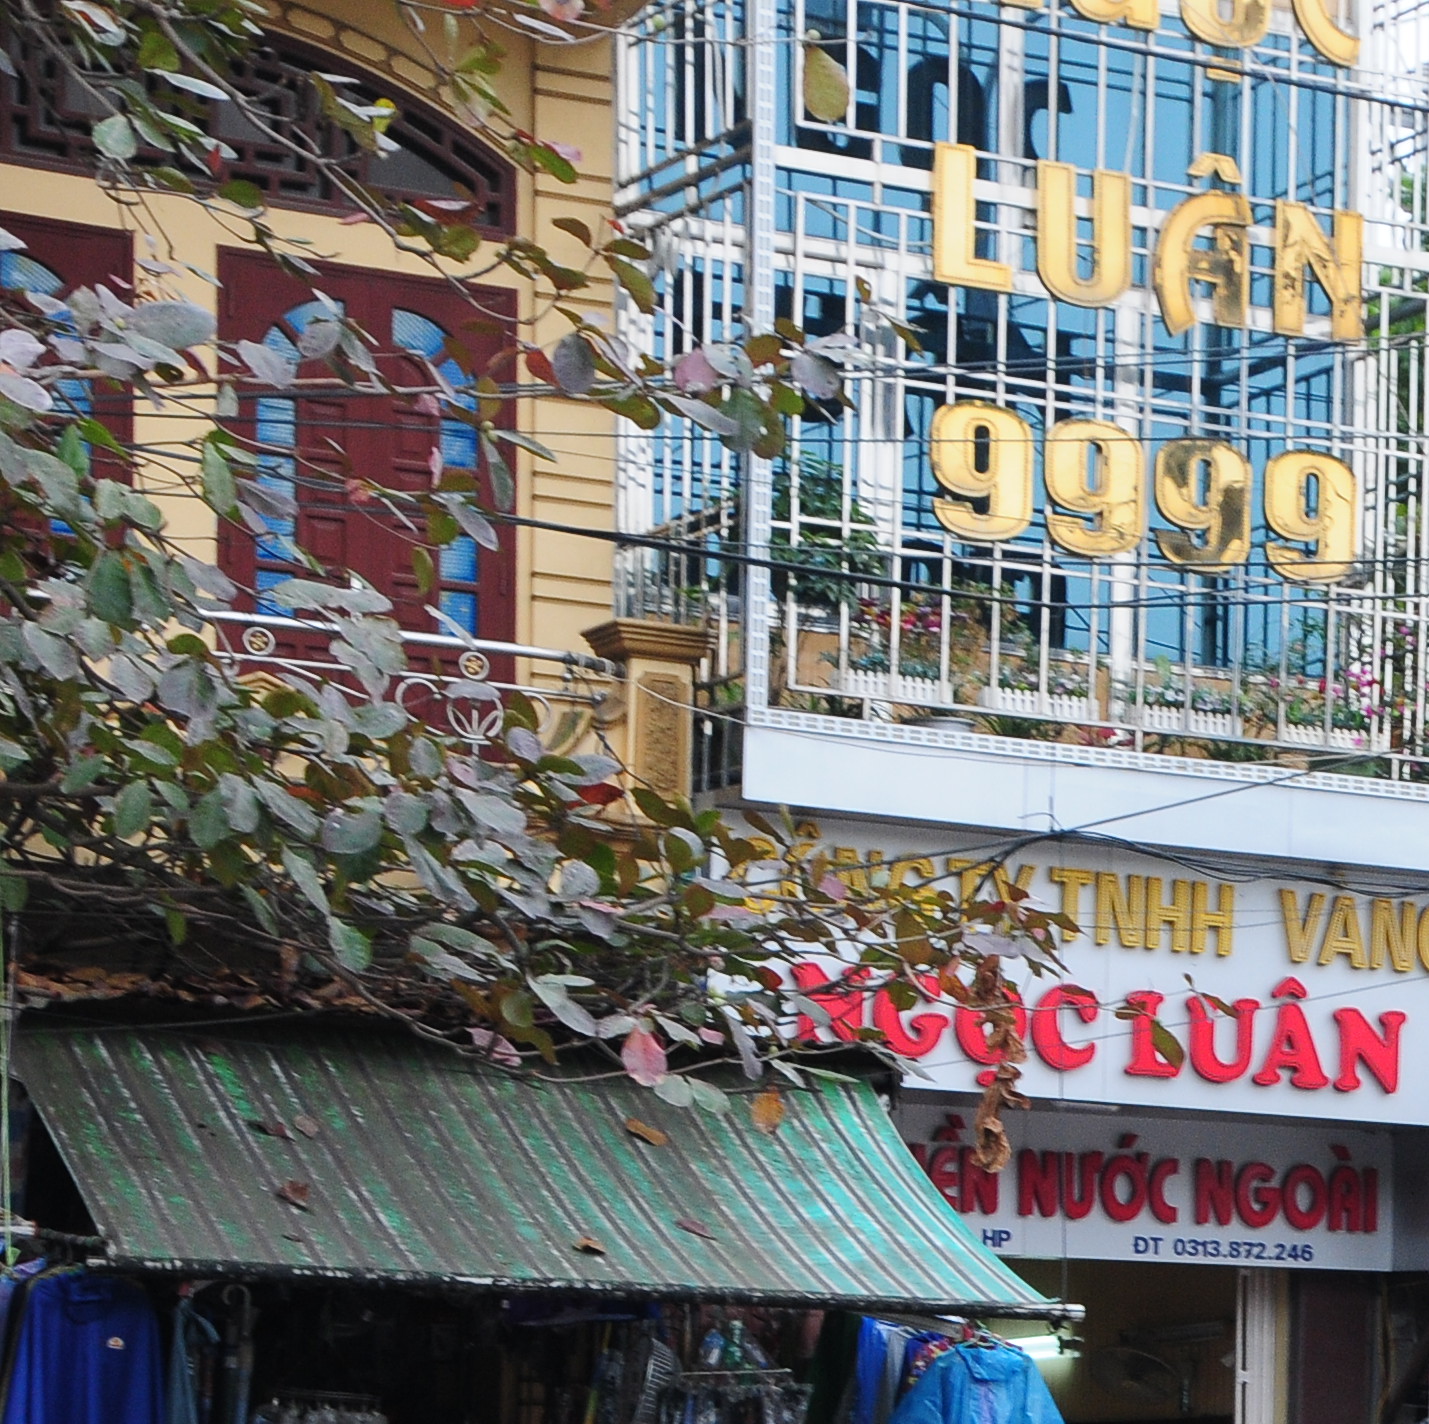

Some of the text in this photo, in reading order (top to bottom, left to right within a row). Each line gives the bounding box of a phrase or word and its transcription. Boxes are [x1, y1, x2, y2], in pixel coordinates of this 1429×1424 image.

[930, 143, 1364, 342] LUÂN
[928, 401, 1359, 582] 9999
[1049, 864, 1234, 956] TNHH
[790, 962, 1405, 1094] NGỌC LUÂN
[1019, 1133, 1180, 1224] NƯỚC
[1195, 1144, 1378, 1233] NGOÀI
[982, 1229, 1314, 1262] HP ĐT 0313.872.246
